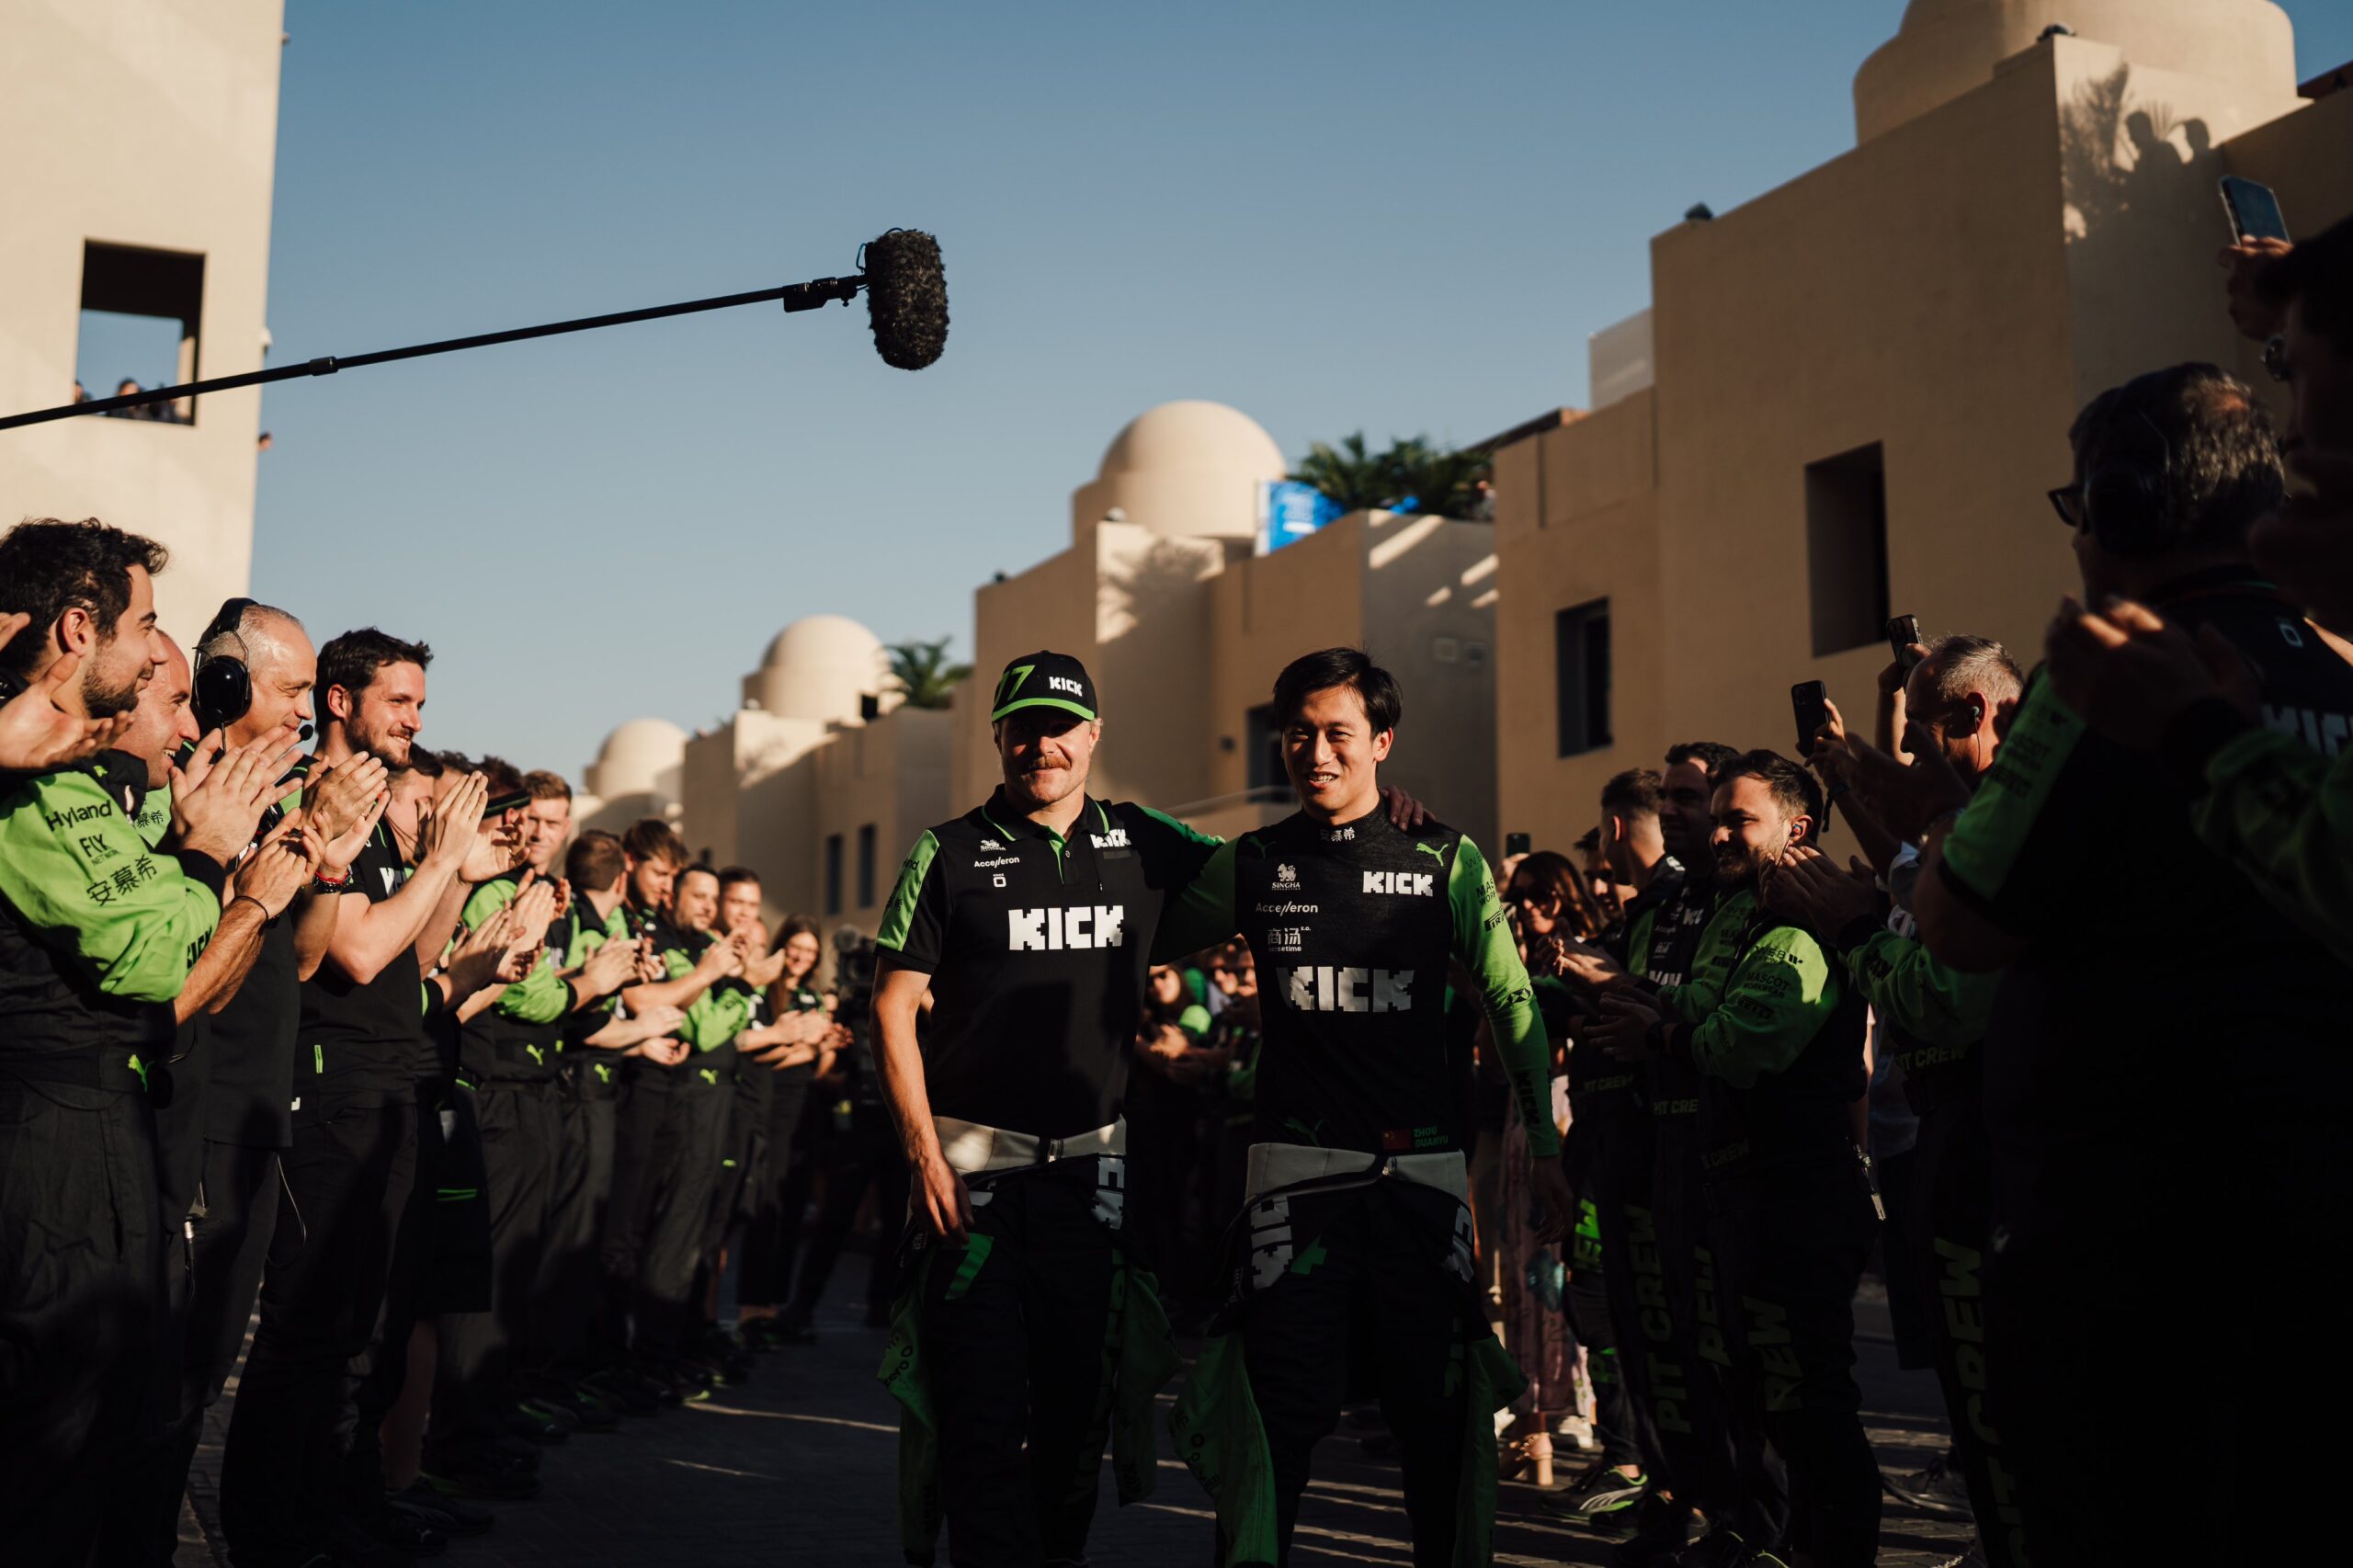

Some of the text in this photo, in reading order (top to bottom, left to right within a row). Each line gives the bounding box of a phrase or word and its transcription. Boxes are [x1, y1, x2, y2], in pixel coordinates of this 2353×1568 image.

[1049, 676, 1083, 697] KICK
[46, 800, 112, 832] Hyland
[137, 810, 164, 828] 慕希
[1090, 829, 1131, 848] KICK
[86, 854, 157, 906] 安慕希
[1363, 870, 1433, 897] KICK
[1008, 905, 1124, 950] KICK
[1275, 966, 1415, 1012] KICK
[1518, 1073, 1540, 1125] KICK
[1671, 1097, 1699, 1114] CRE
[1414, 1125, 1438, 1137] ZHOU
[1742, 1295, 1804, 1413] REW
